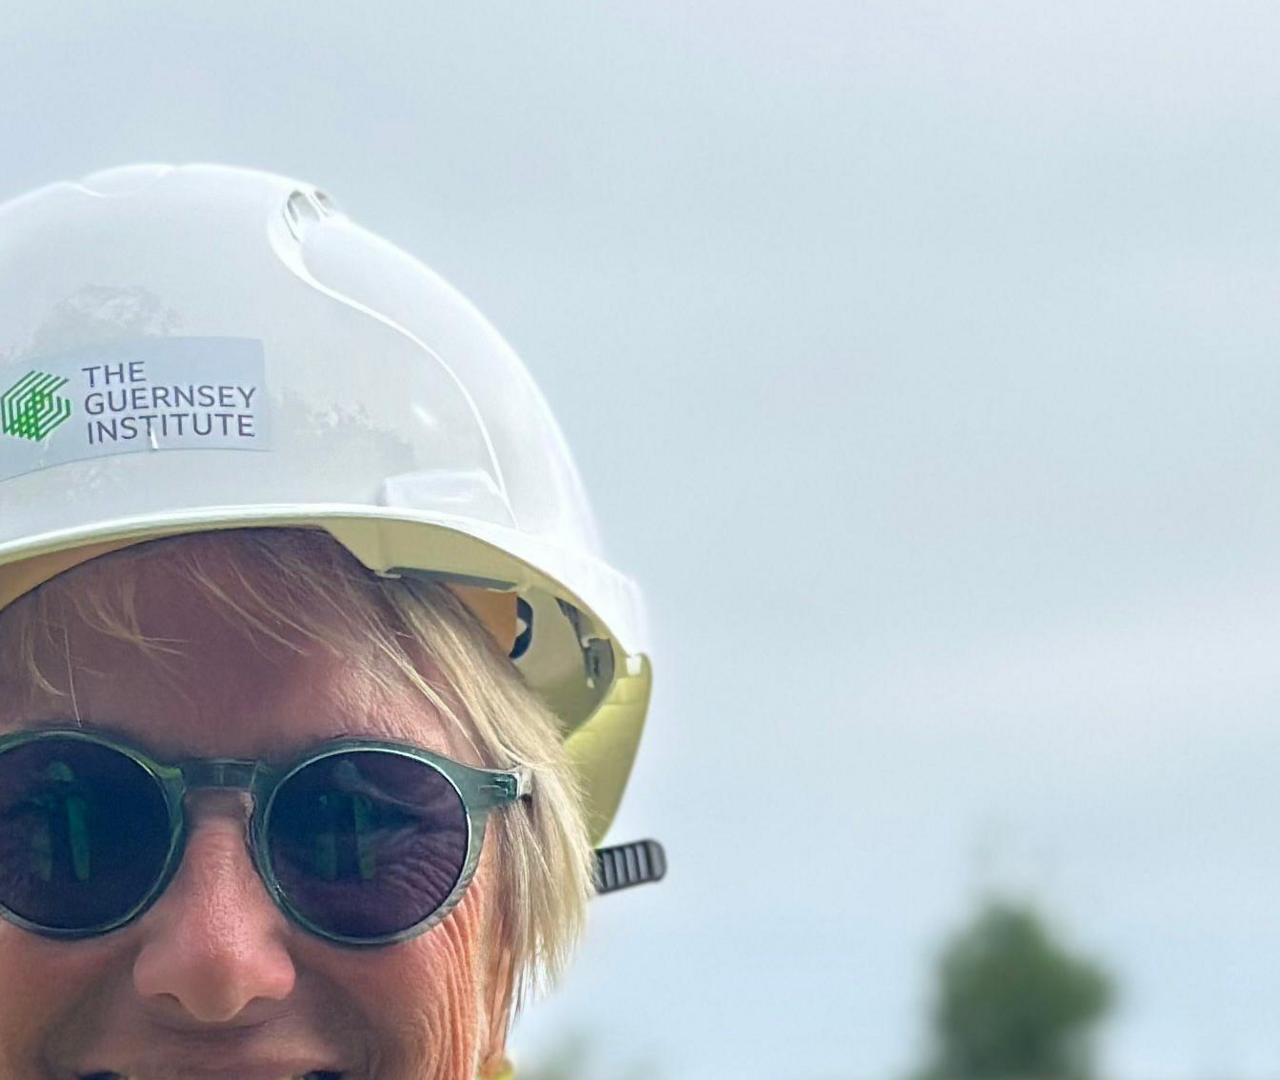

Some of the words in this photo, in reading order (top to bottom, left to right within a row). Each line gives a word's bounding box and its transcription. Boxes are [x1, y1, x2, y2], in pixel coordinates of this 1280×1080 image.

[81, 361, 147, 388] THE
[84, 385, 257, 416] GUERNSEY
[87, 413, 256, 445] INSTITUTE
